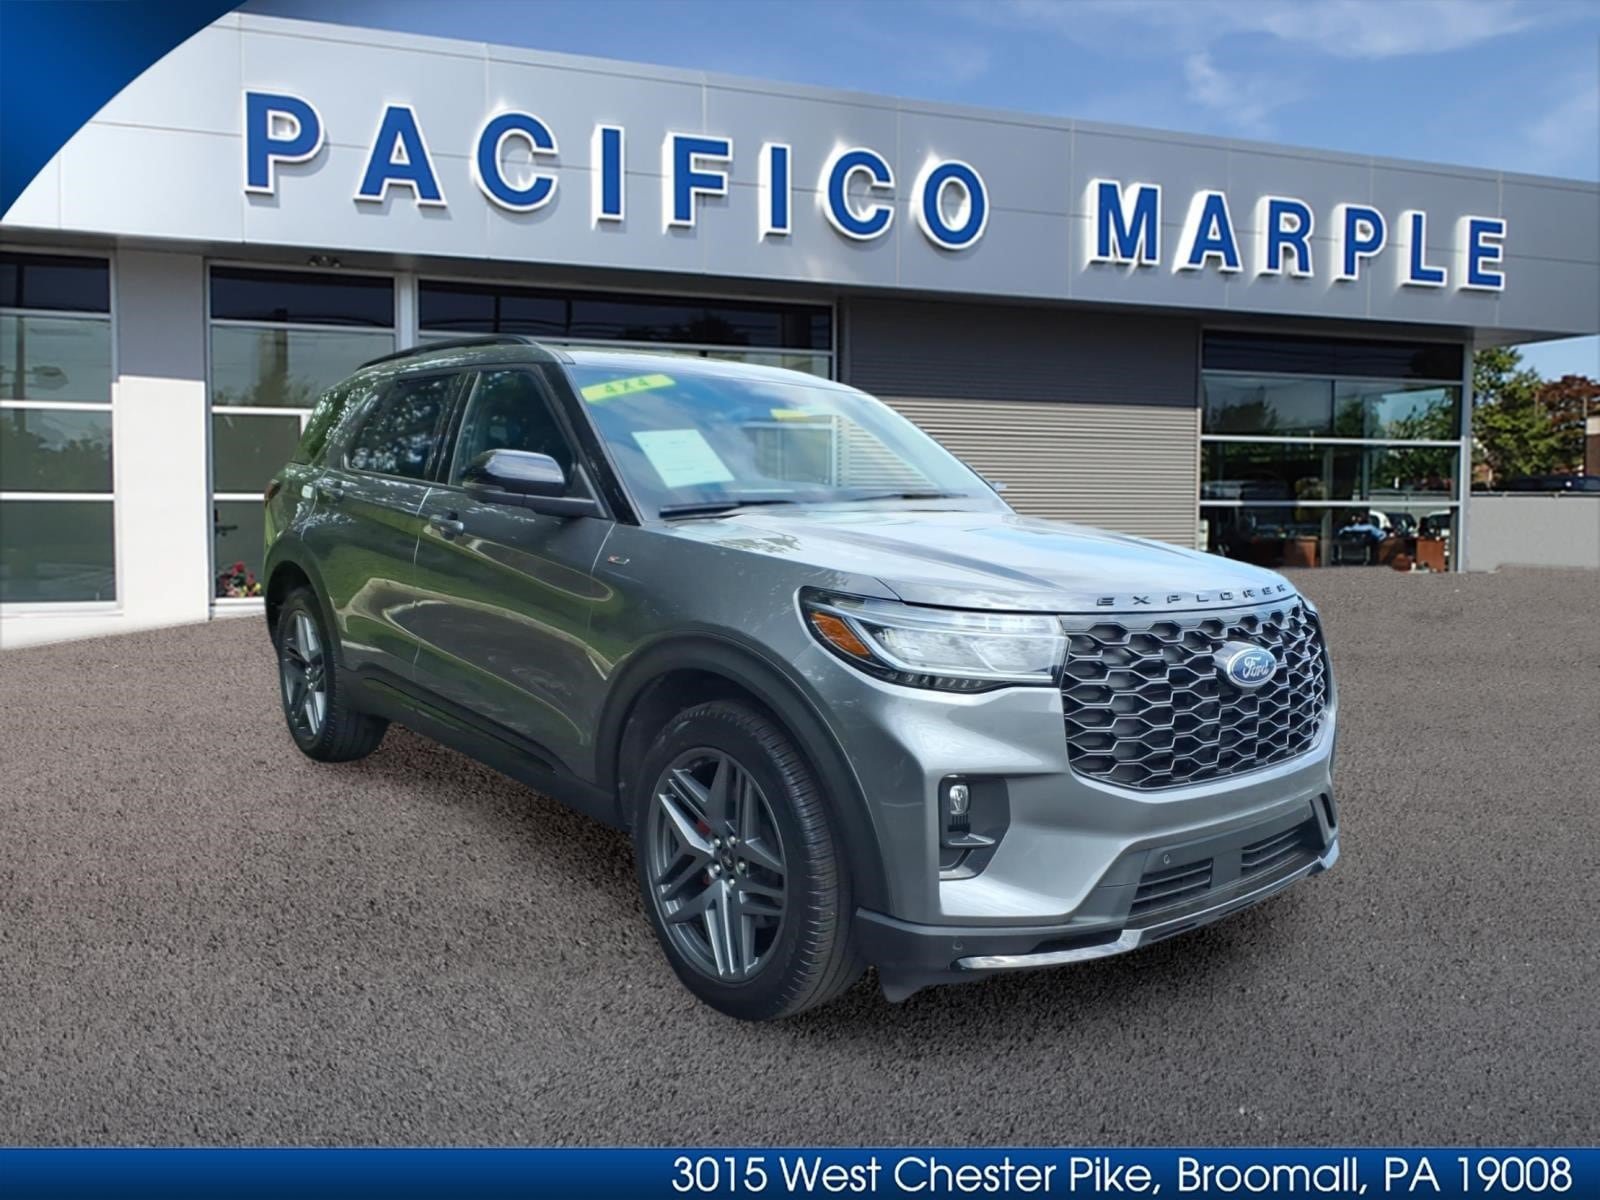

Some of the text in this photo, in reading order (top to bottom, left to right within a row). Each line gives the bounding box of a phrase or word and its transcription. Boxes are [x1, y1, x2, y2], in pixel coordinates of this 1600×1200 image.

[244, 90, 1506, 292] PACIFICO MARPLE
[1095, 583, 1287, 607] EXPLORER
[1242, 655, 1271, 679] Ford
